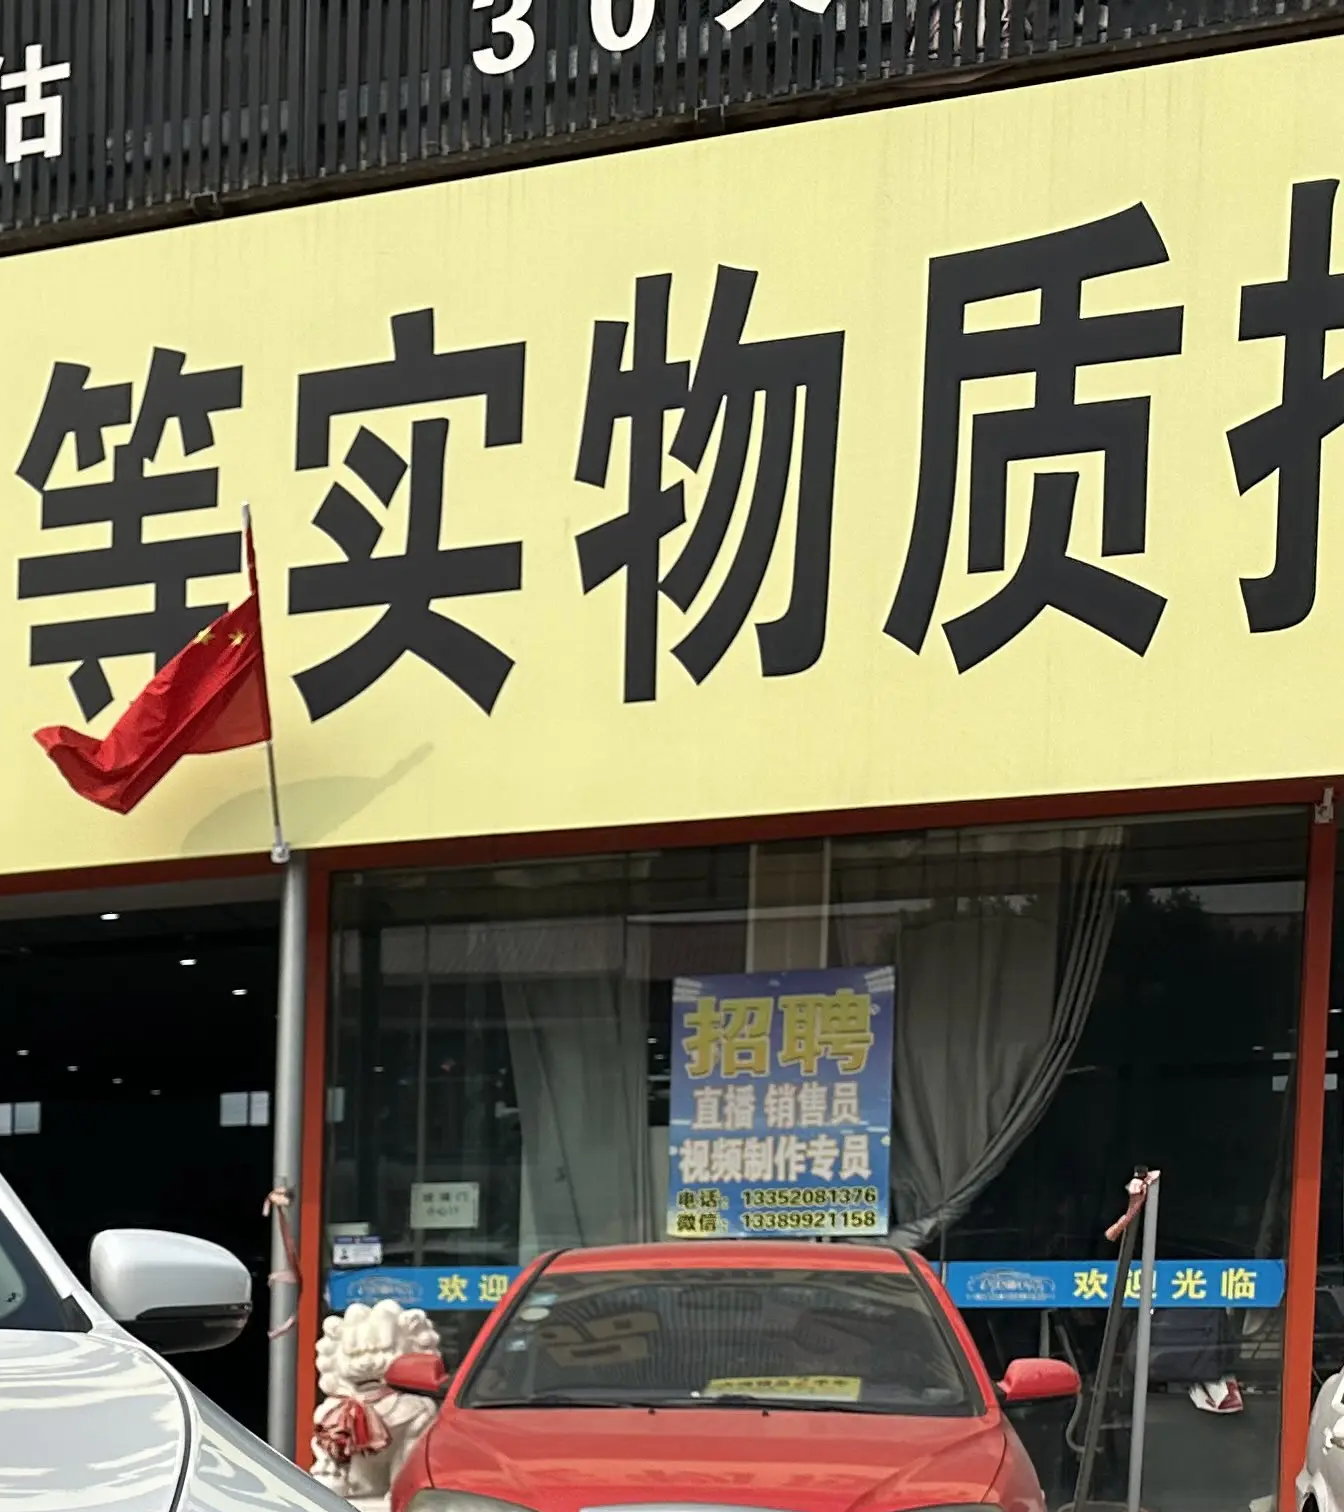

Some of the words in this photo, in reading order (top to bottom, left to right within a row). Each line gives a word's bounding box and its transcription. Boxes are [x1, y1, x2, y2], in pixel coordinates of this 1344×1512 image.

[471, 0, 831, 75] 30
[681, 987, 874, 1079] 招聘
[691, 1083, 756, 1131] 直播
[764, 1080, 862, 1128] 销售员
[678, 1133, 872, 1184] 视频制作专员
[741, 1186, 878, 1208] 13352081376
[741, 1210, 878, 1231] 13389921158
